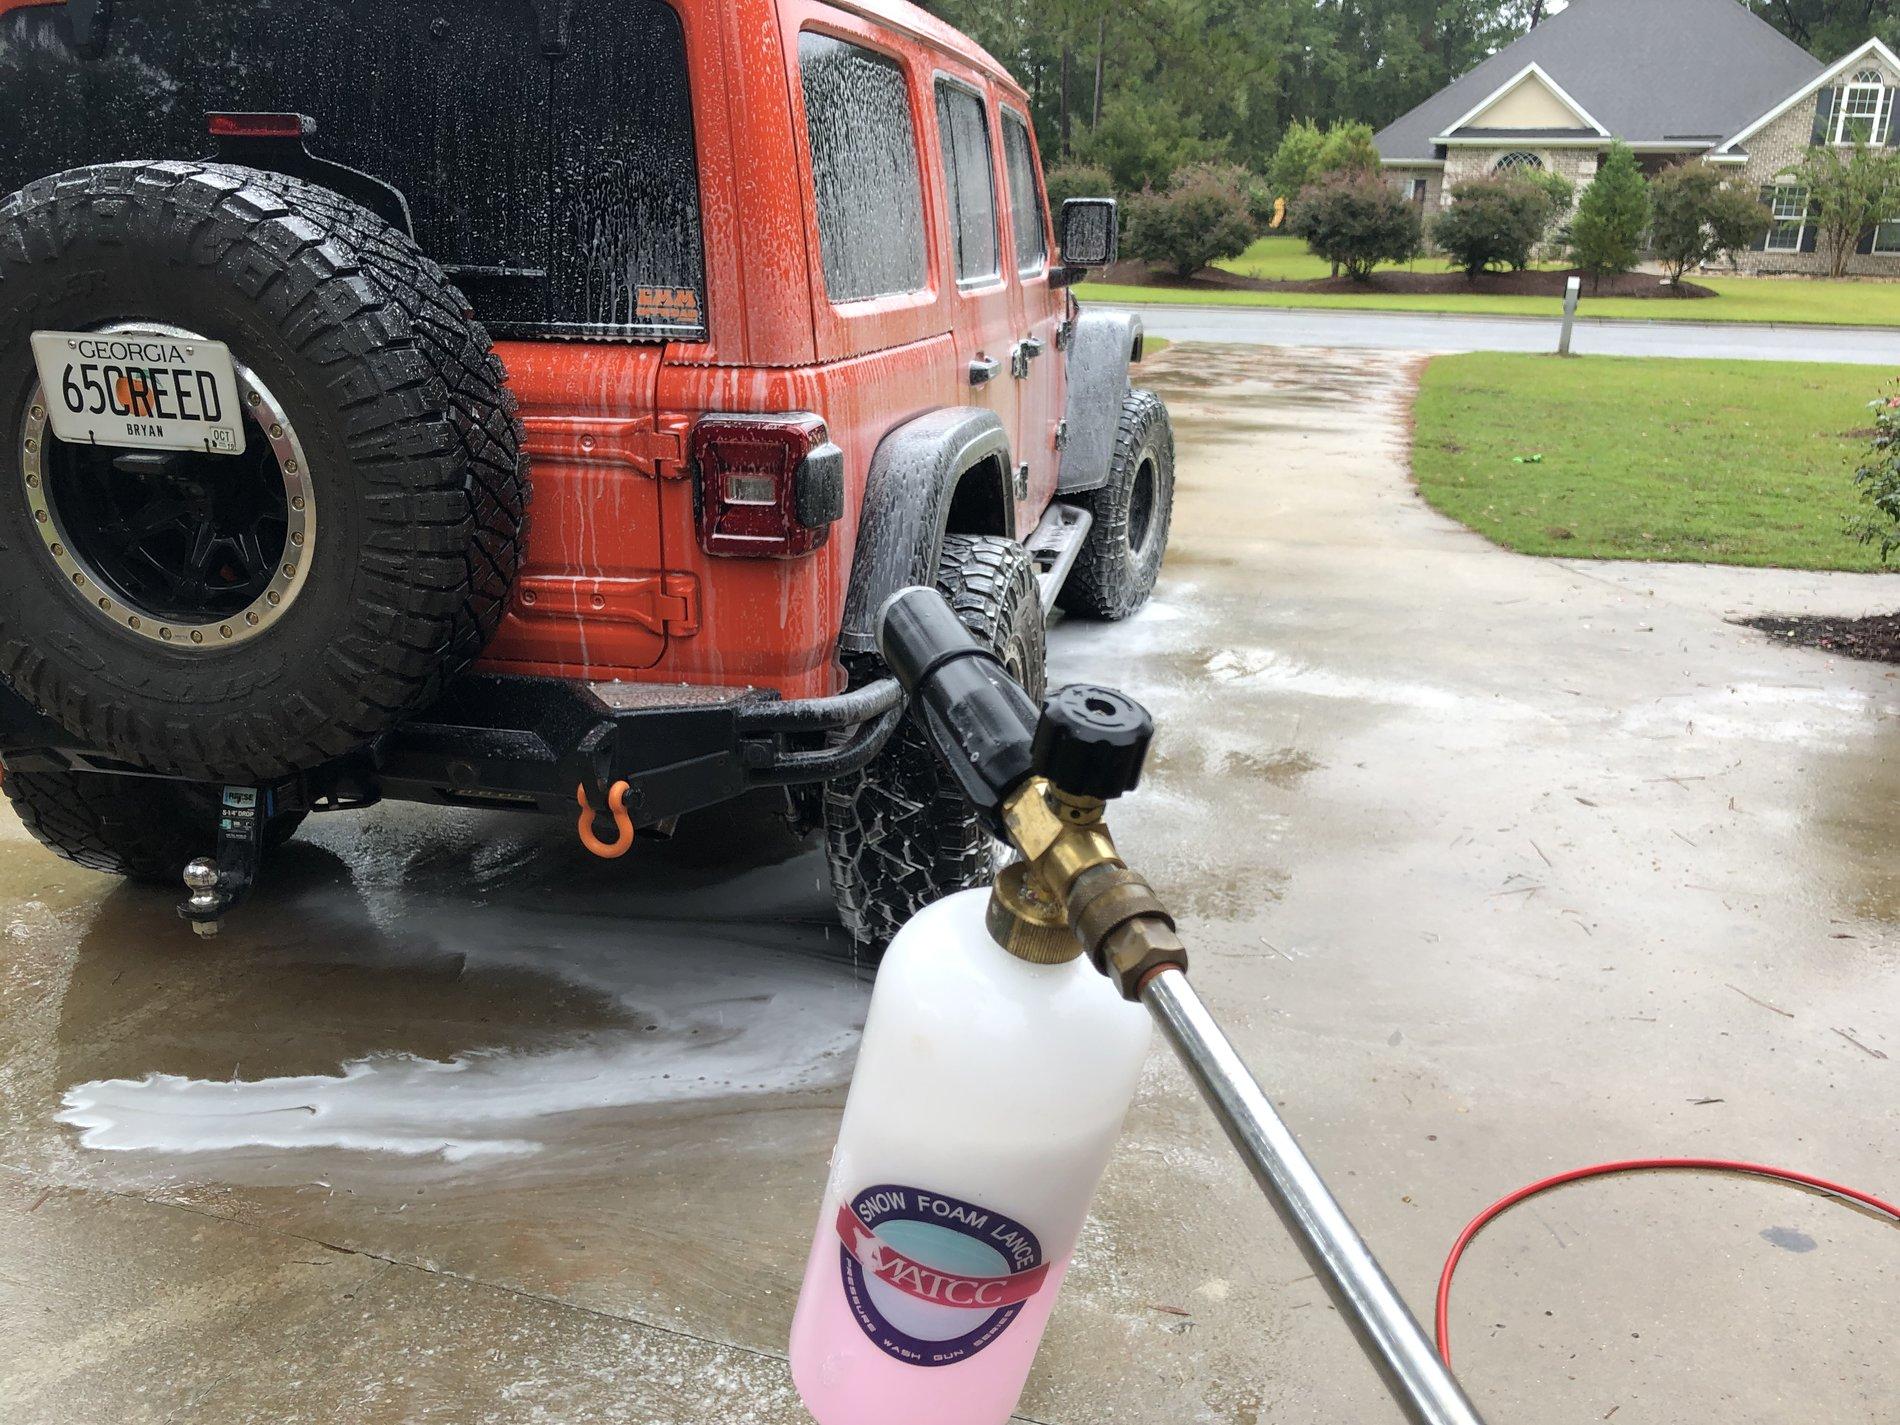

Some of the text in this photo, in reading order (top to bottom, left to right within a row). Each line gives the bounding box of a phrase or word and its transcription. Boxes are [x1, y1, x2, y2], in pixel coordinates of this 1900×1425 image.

[78, 340, 185, 364] GEORGIA
[62, 363, 222, 422] 65CREED
[127, 423, 164, 438] BRYAN
[213, 429, 230, 442] OCT
[859, 1191, 1034, 1270] SNOW FOAM LANCE
[872, 1247, 1008, 1305] MATCC
[846, 1257, 1014, 1362] PRESSURE WASH GUN SERIES
